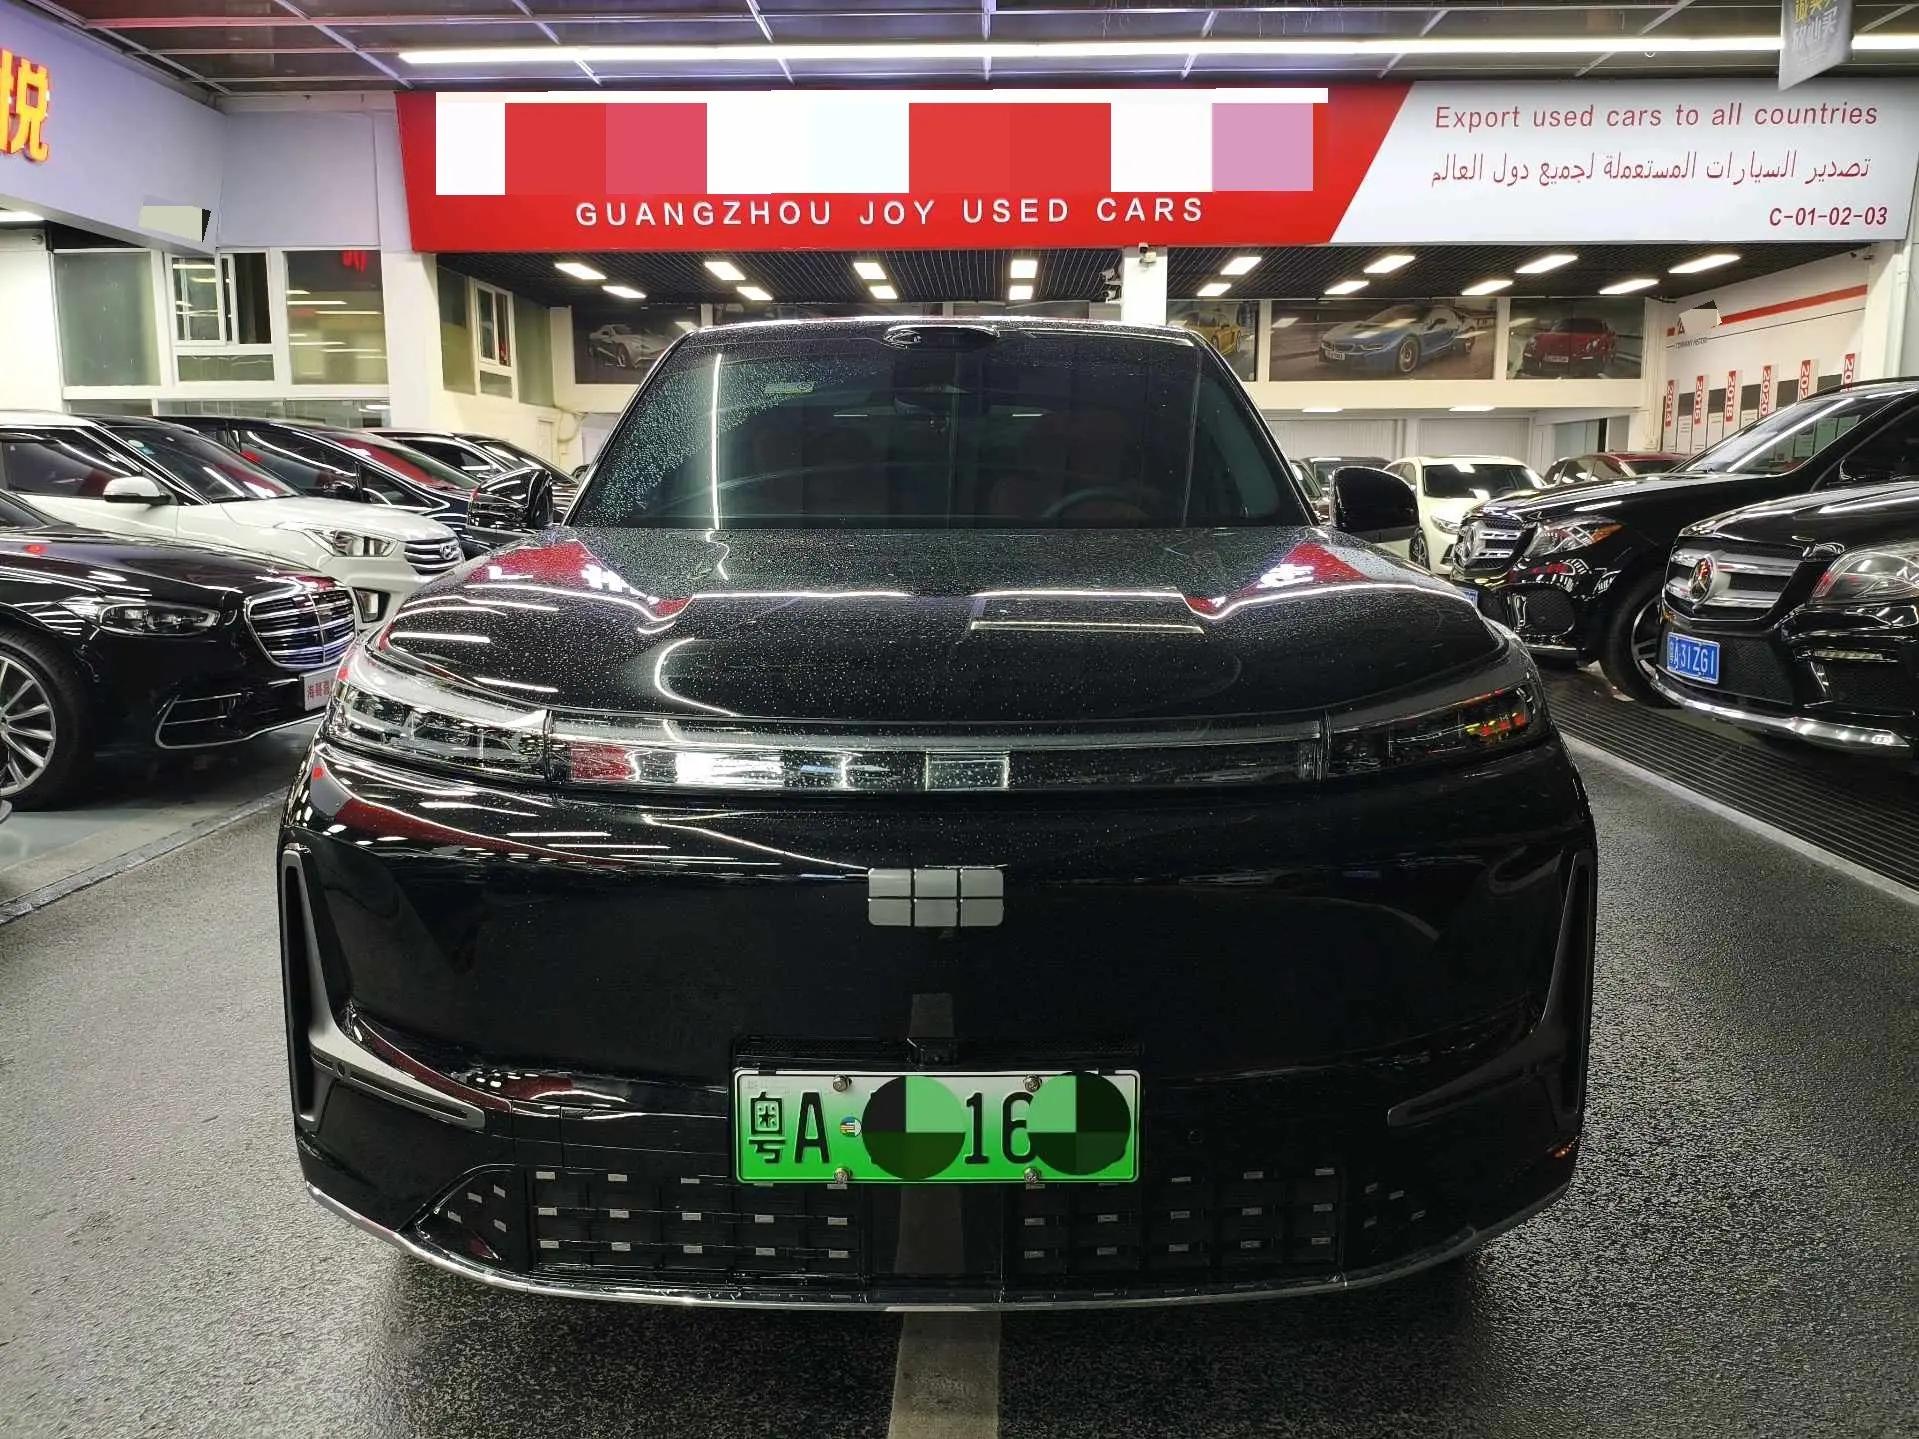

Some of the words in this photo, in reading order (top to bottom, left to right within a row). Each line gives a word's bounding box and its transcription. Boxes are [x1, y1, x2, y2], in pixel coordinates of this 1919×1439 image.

[1435, 105, 1521, 133] Export
[1533, 103, 1594, 128] used
[1606, 108, 1663, 128] cars
[1675, 103, 1699, 127] to
[1711, 102, 1743, 126] all
[1754, 101, 1878, 126] countries
[1431, 153, 1484, 188] العالم
[1492, 152, 1530, 187] دول
[1538, 151, 1595, 187] لجميع
[1603, 151, 1697, 180] المستعملة
[1706, 150, 1797, 186] السيارات
[1804, 158, 1872, 185] تصدير
[575, 200, 831, 227] GUANGZHOU
[859, 199, 935, 226] JOY
[962, 198, 1069, 224] USED
[1096, 197, 1203, 223] CARS
[1769, 206, 1888, 227] C-01-02-03
[1726, 375, 1736, 417] 2018
[1760, 369, 1772, 415] 2020
